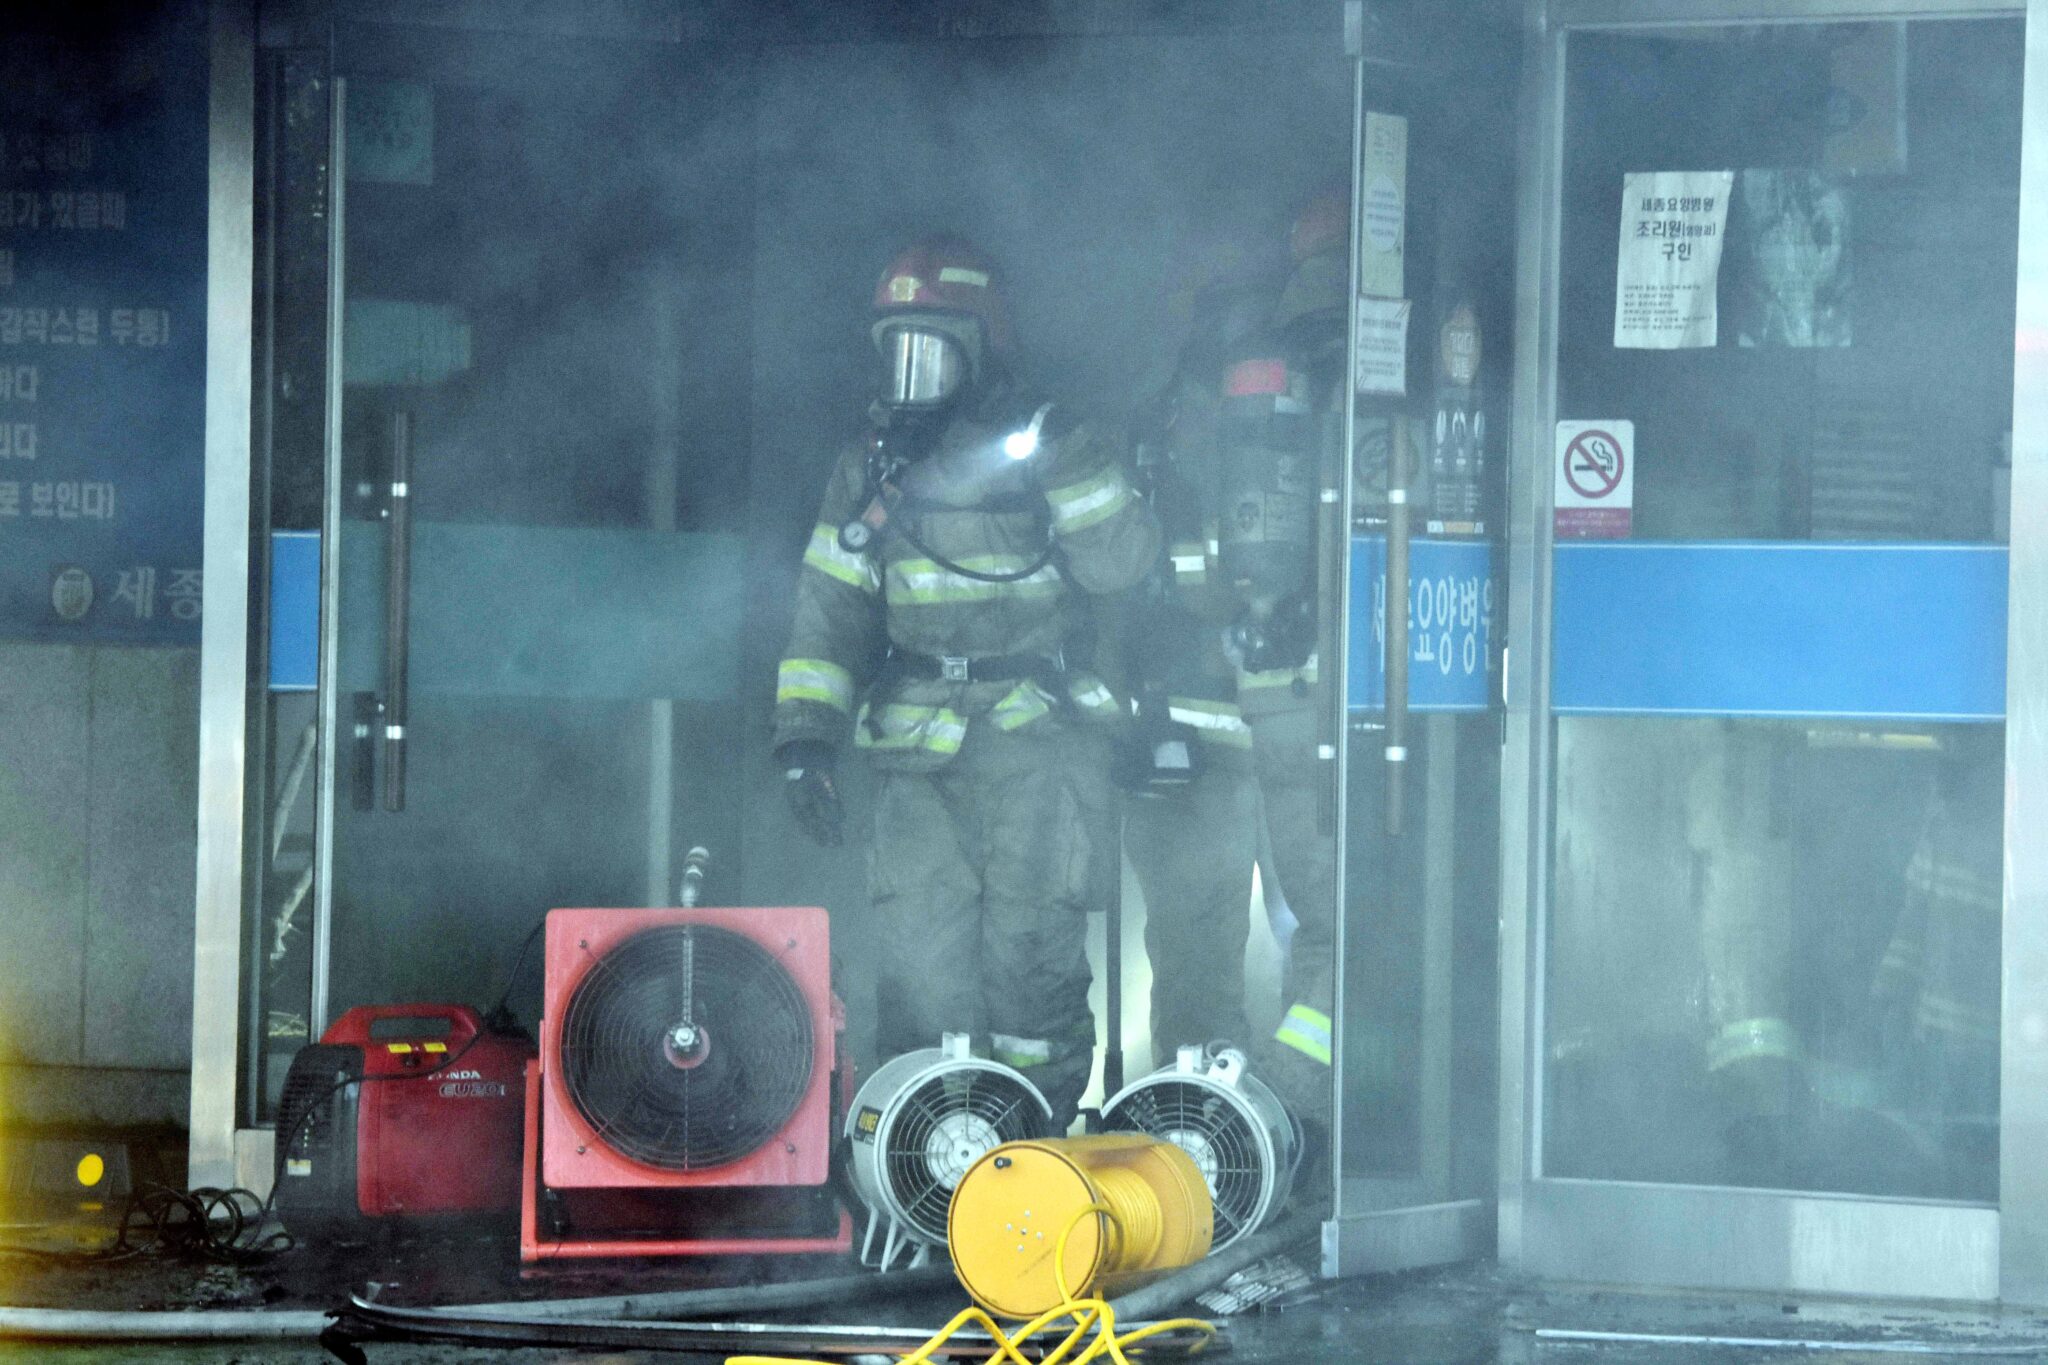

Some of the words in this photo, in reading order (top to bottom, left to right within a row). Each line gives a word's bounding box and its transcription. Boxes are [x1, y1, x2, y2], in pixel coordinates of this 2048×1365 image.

[1641, 197, 1714, 212] 세종요양병원
[1661, 243, 1691, 261] 구인
[0, 307, 99, 344] 갑작스런
[31, 480, 116, 519] 보인다)
[112, 566, 203, 620] 세종
[1370, 575, 1493, 676] 세요양병
